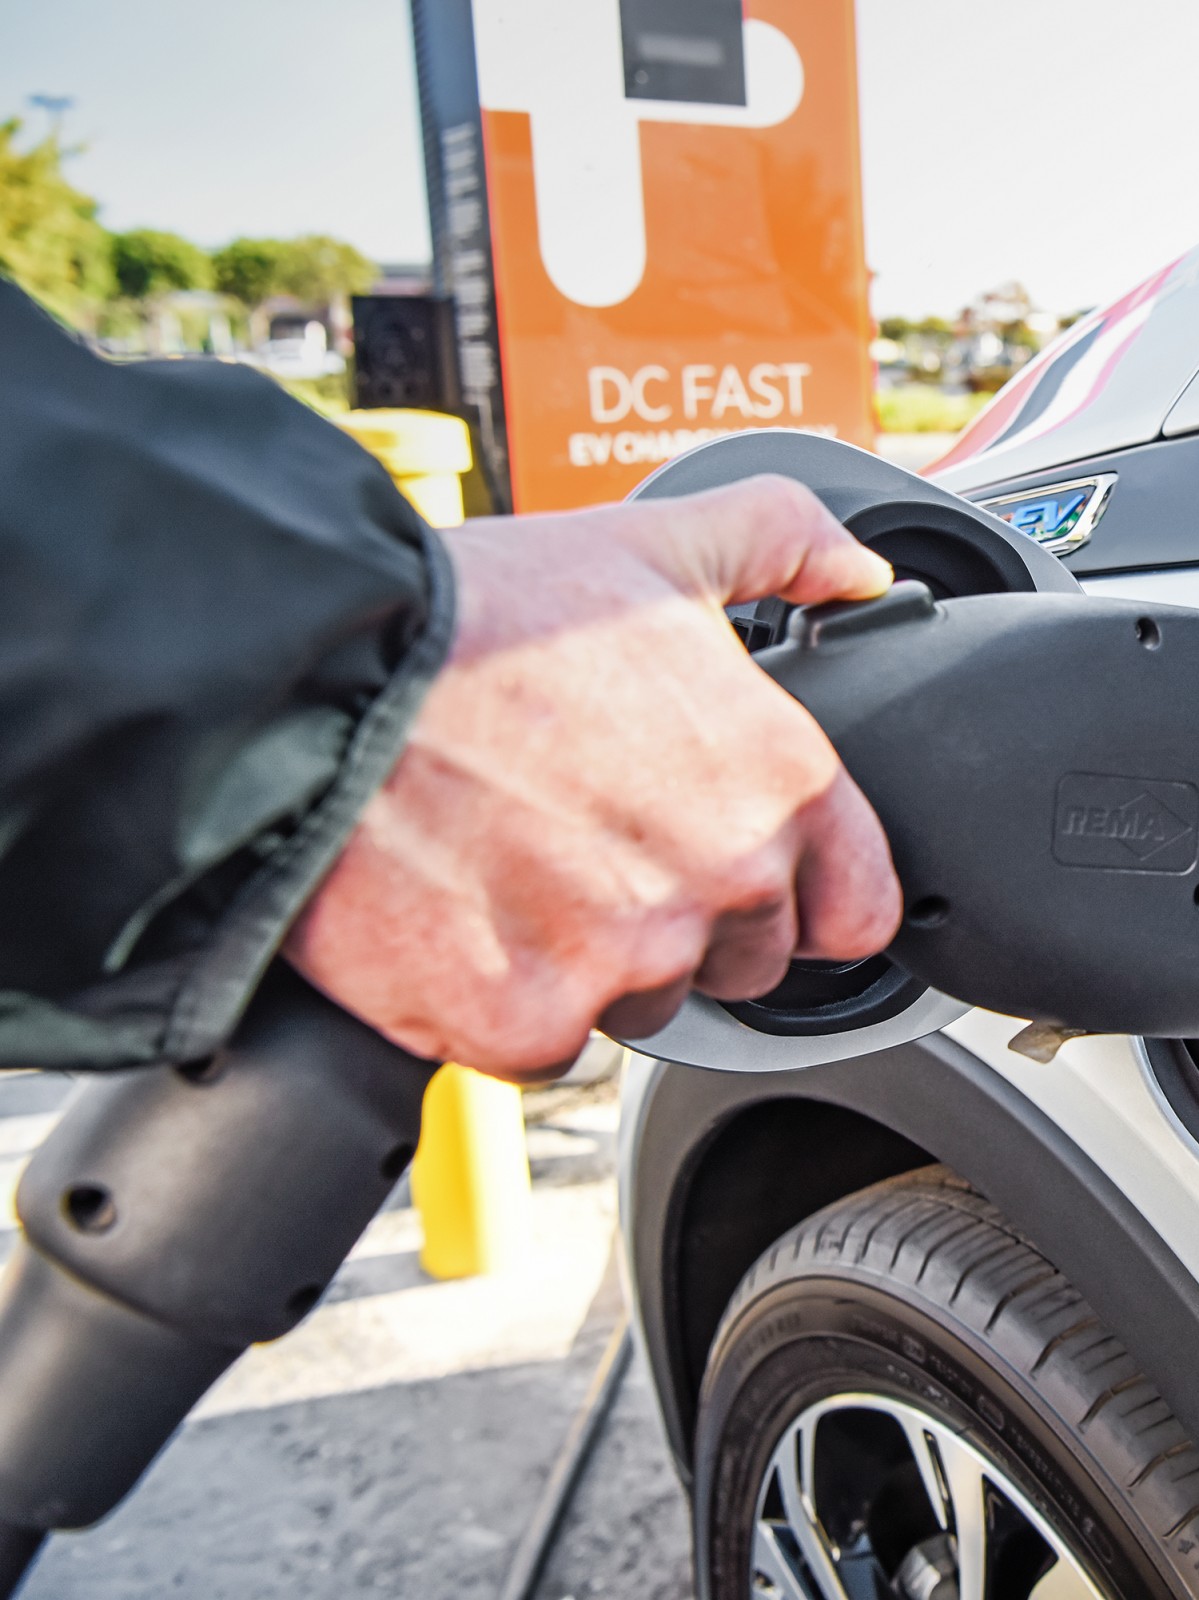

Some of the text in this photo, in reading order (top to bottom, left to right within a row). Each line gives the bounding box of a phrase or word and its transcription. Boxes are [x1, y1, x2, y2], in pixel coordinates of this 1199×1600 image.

[588, 362, 813, 424] DC FAST
[1010, 494, 1086, 535] EV
[1061, 805, 1166, 842] REMA
